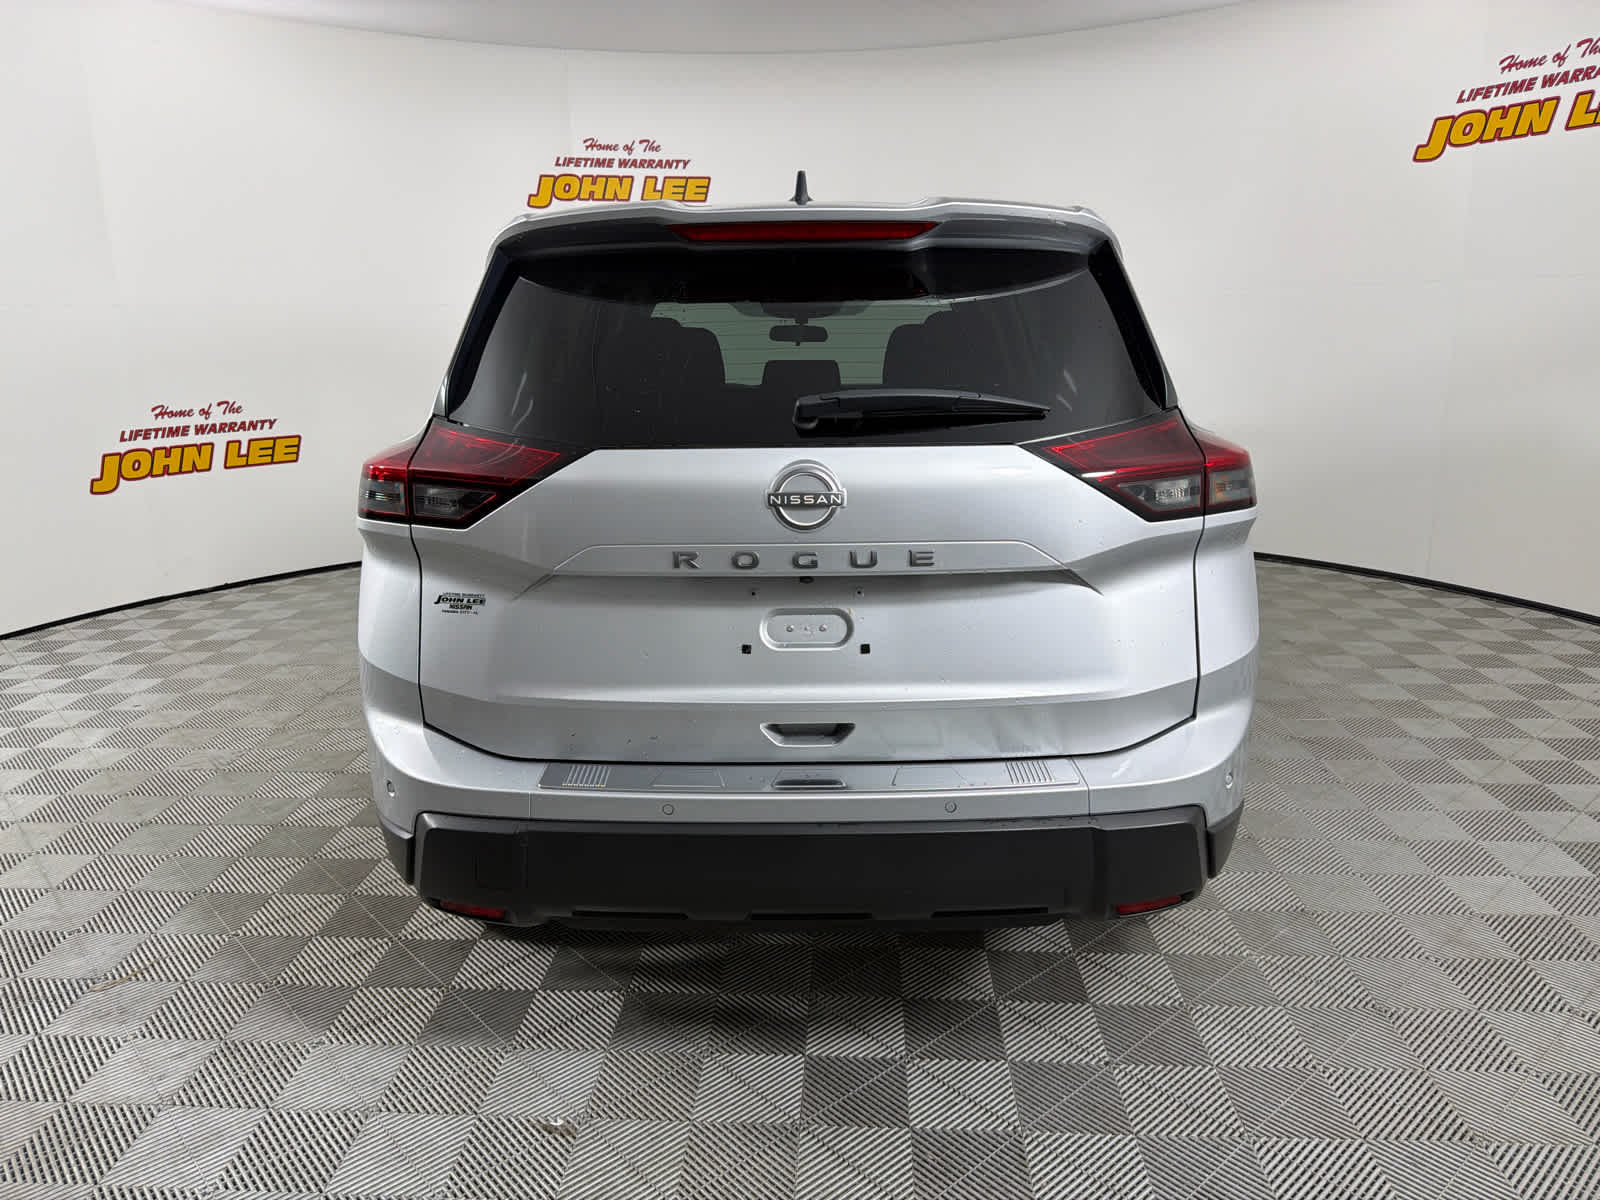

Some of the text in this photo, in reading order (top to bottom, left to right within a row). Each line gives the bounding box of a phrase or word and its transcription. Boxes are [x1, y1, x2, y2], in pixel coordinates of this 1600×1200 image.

[1499, 37, 1600, 74] Home of Th
[1456, 77, 1538, 104] LIFETIME
[1412, 89, 1600, 163] JOHN L
[582, 137, 662, 155] Home of The
[554, 157, 691, 170] LIFETIME WARRANTY
[527, 173, 711, 209] JOHN LEE
[151, 400, 244, 420] Home of The
[119, 418, 279, 443] LIFETIME WARRANTY
[90, 434, 302, 495] JOHN LEE
[769, 494, 843, 505] NISSAN
[672, 550, 936, 570] ROGUE
[433, 594, 465, 605] JOHN
